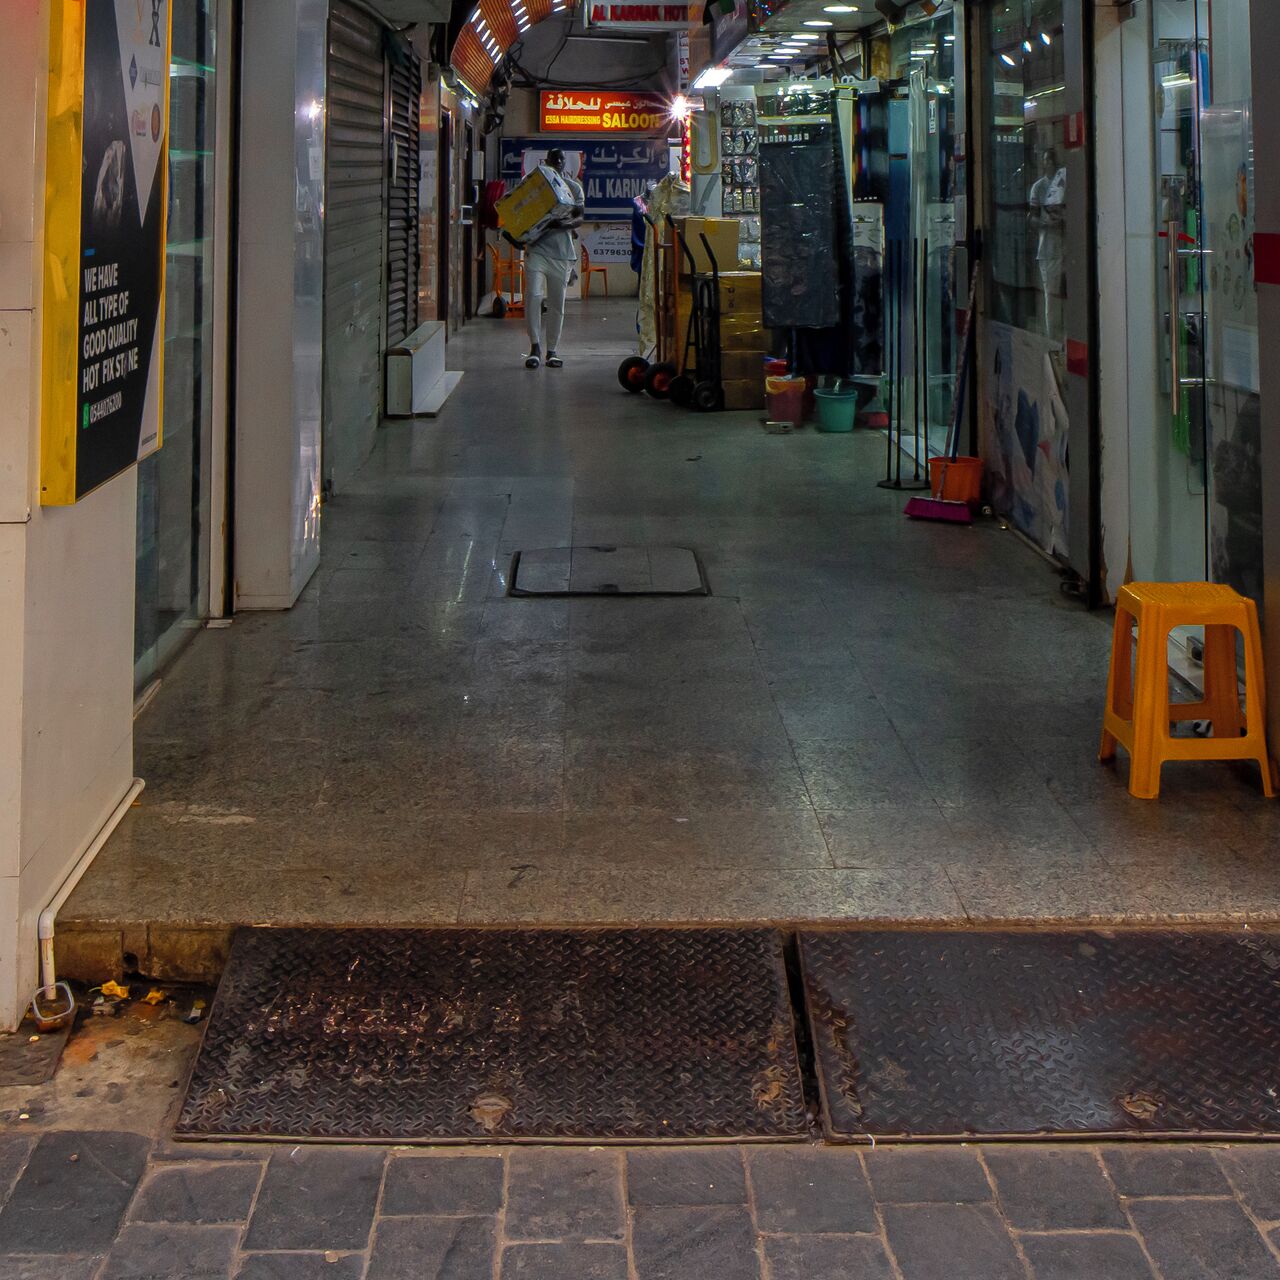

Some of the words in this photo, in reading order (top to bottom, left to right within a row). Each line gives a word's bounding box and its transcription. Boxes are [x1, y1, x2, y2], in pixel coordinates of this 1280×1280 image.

[587, 178, 603, 198] AL
[84, 268, 97, 293] WE
[97, 263, 119, 290] HAVE
[83, 300, 98, 327] ALL
[99, 294, 118, 321] TYPE
[119, 291, 129, 315] OF
[83, 329, 107, 360] GOOD
[107, 318, 139, 350] QUALITY
[82, 362, 100, 393] HOT
[102, 357, 115, 384] FIX
